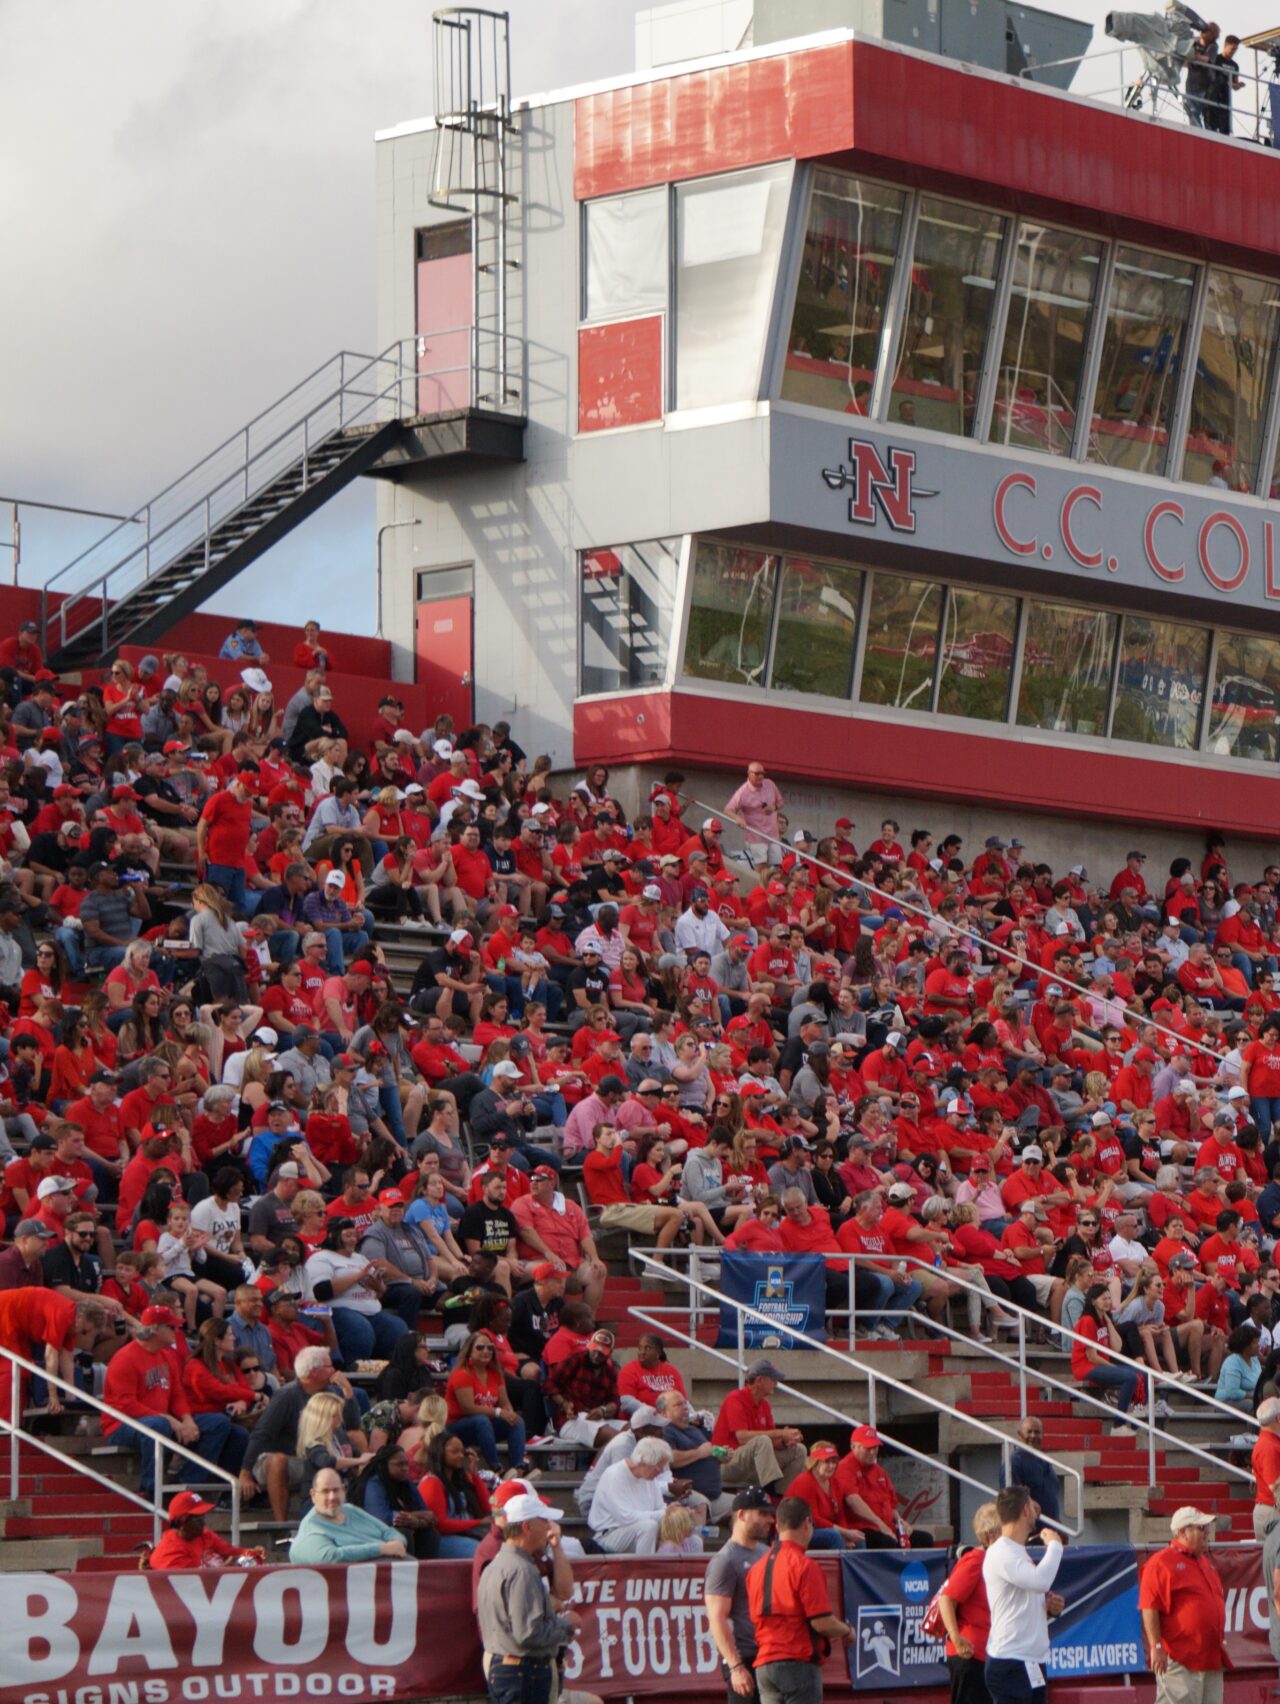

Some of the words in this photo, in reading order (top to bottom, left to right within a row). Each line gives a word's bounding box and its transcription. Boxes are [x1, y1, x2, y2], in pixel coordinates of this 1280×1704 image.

[993, 472, 1120, 573] C.C.
[758, 1302, 788, 1312] FOOTBALL
[904, 1580, 930, 1593] NCAA
[905, 1605, 924, 1617] 2019
[0, 1561, 419, 1688] BAYOU
[181, 1672, 397, 1699] OUTDOOR
